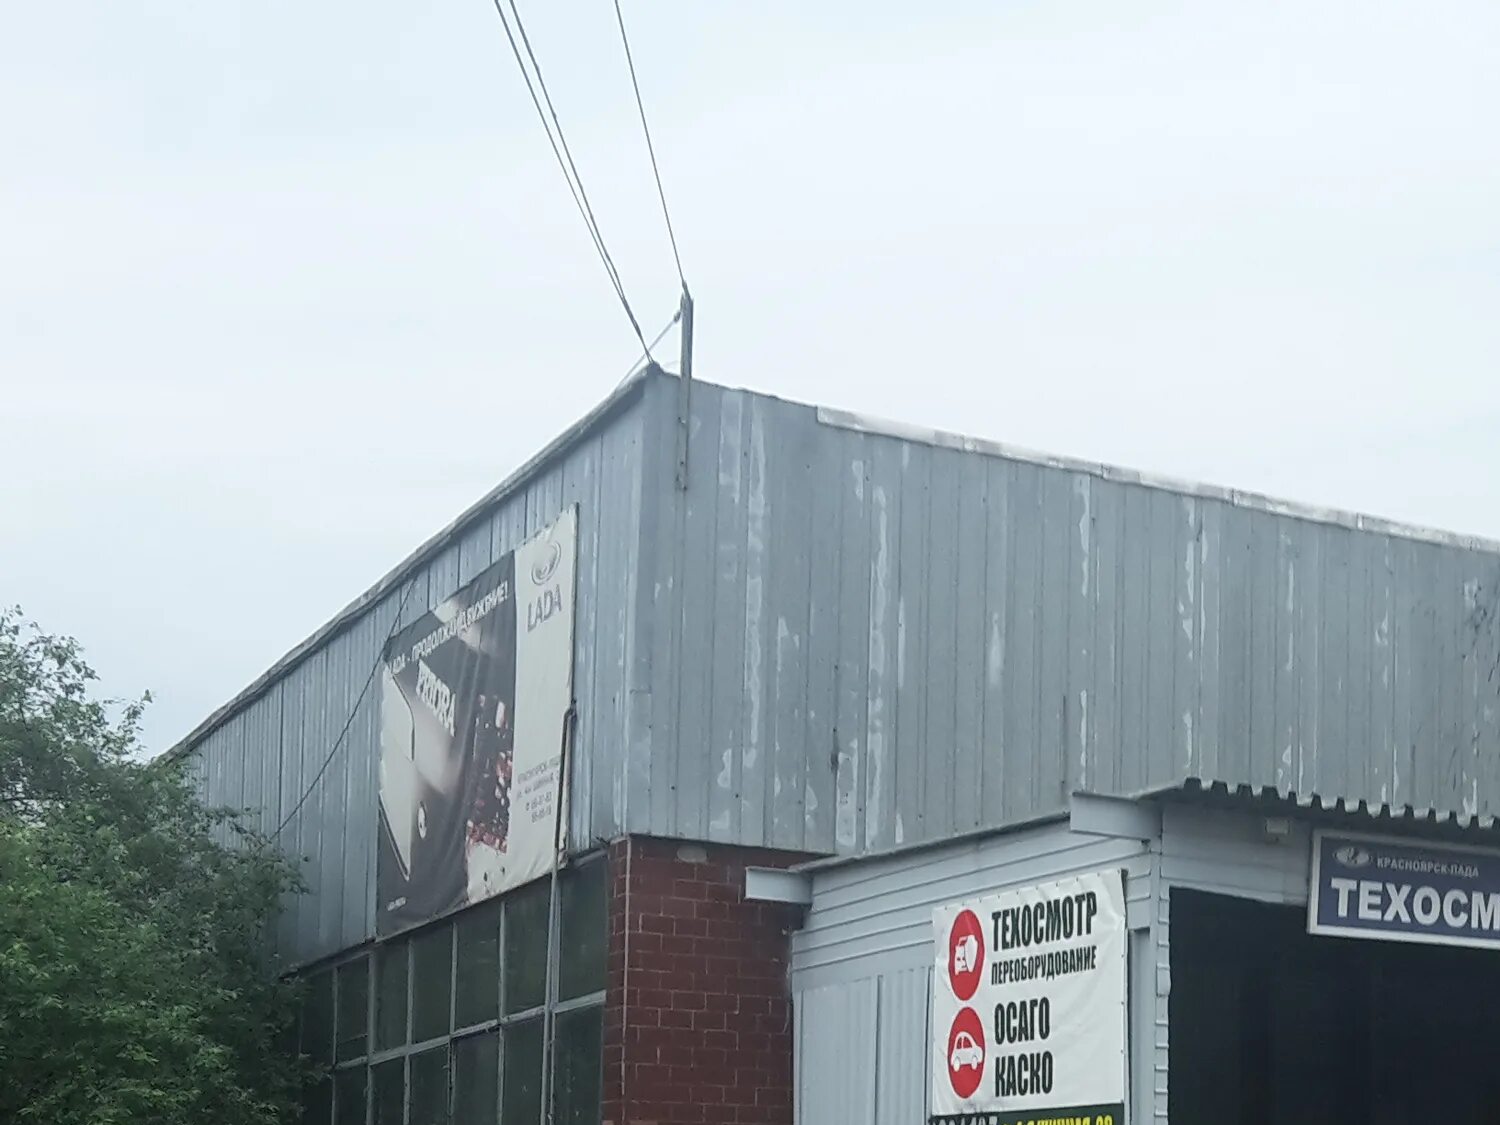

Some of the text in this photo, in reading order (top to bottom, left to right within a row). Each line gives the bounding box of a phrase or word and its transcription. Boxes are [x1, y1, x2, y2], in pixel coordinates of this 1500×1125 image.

[527, 584, 562, 633] LADA
[415, 658, 456, 737] PRIORA
[991, 891, 1098, 951] ТЕХОСМОТР
[991, 945, 1097, 985] ПЕРЕОБОРУДОВАНИЕ
[993, 997, 1050, 1045] ОСАГО
[995, 1051, 1053, 1097] КАСКО
